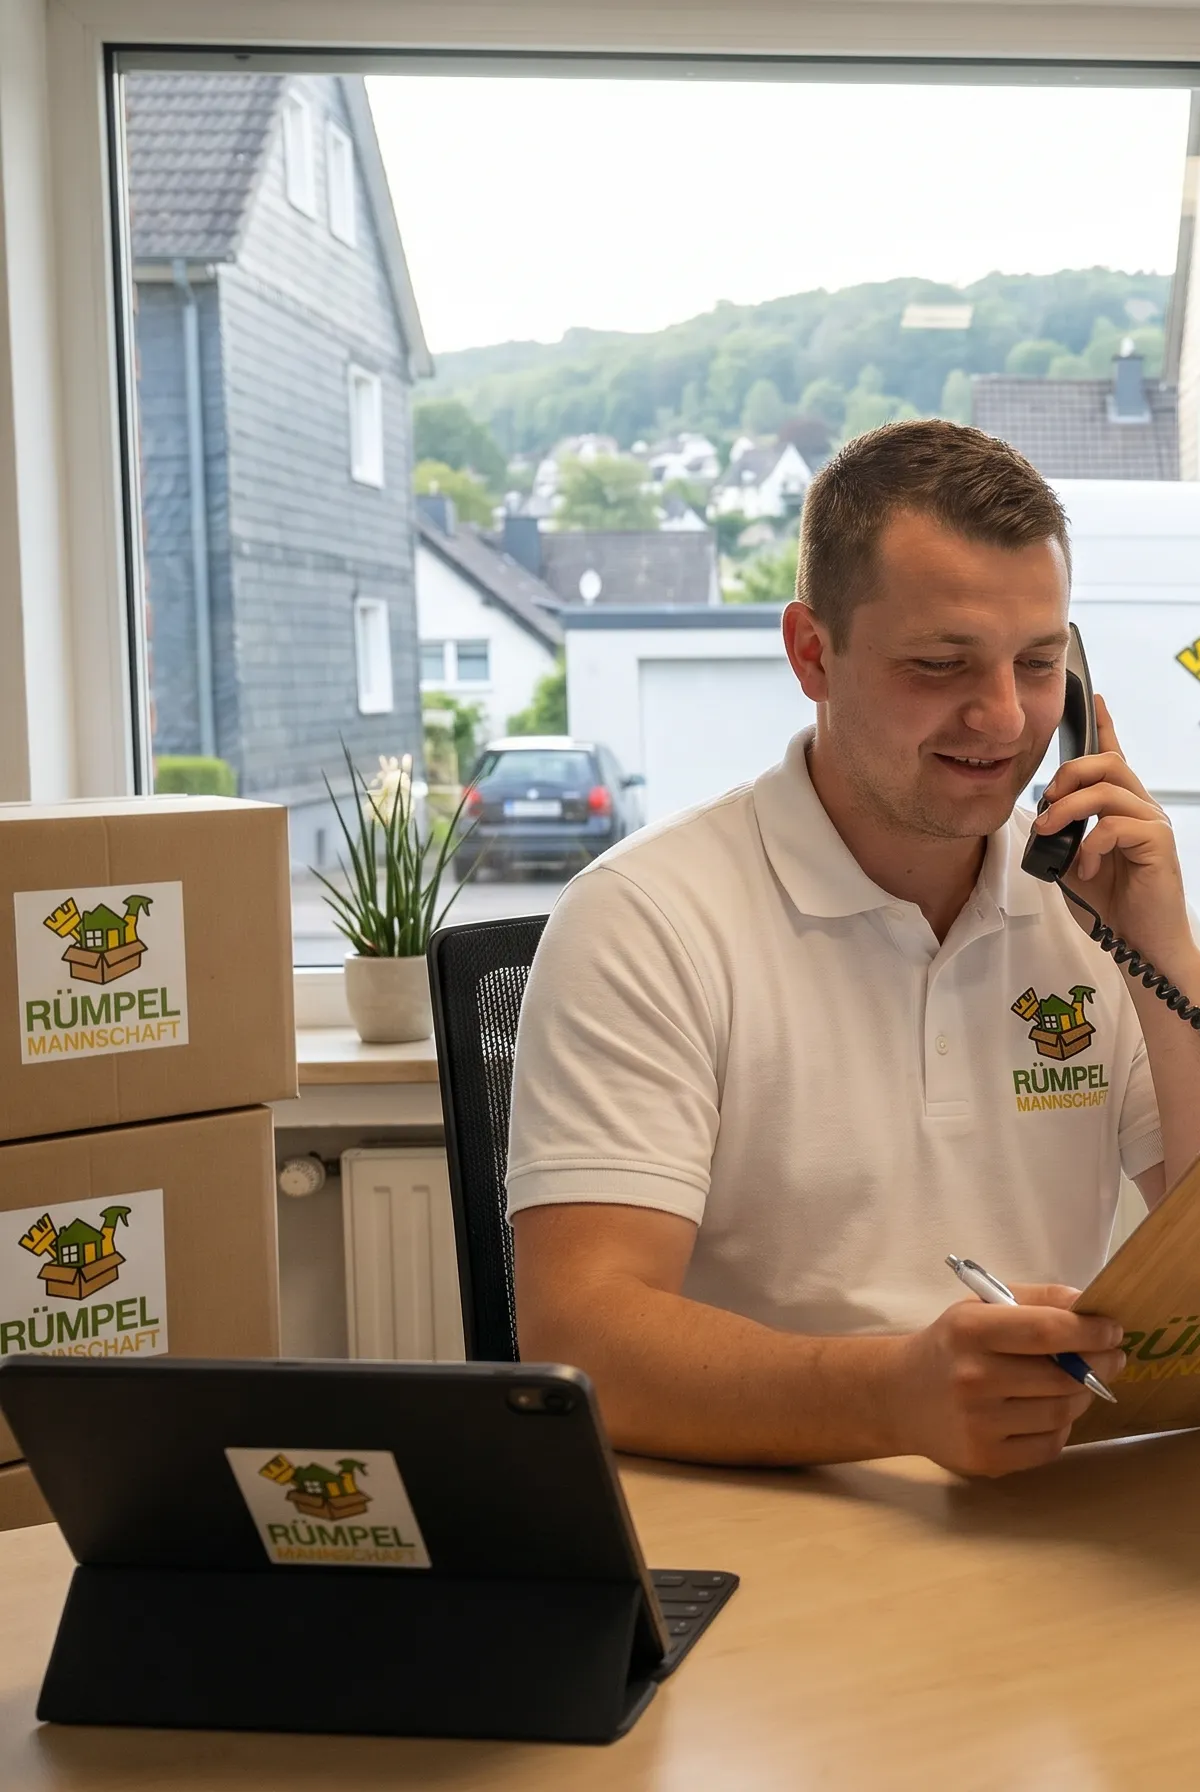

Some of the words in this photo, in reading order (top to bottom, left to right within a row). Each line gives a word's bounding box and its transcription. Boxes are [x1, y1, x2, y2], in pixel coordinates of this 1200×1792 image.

[26, 988, 180, 1032] RÜMPEL
[27, 1020, 180, 1056] MANNSCHAFT
[1012, 1062, 1109, 1094] RÜMPEL
[1016, 1090, 1109, 1112] MANNSCHAFT
[0, 1296, 159, 1354] RÜMPEL
[266, 1519, 415, 1548] RÜMPEL
